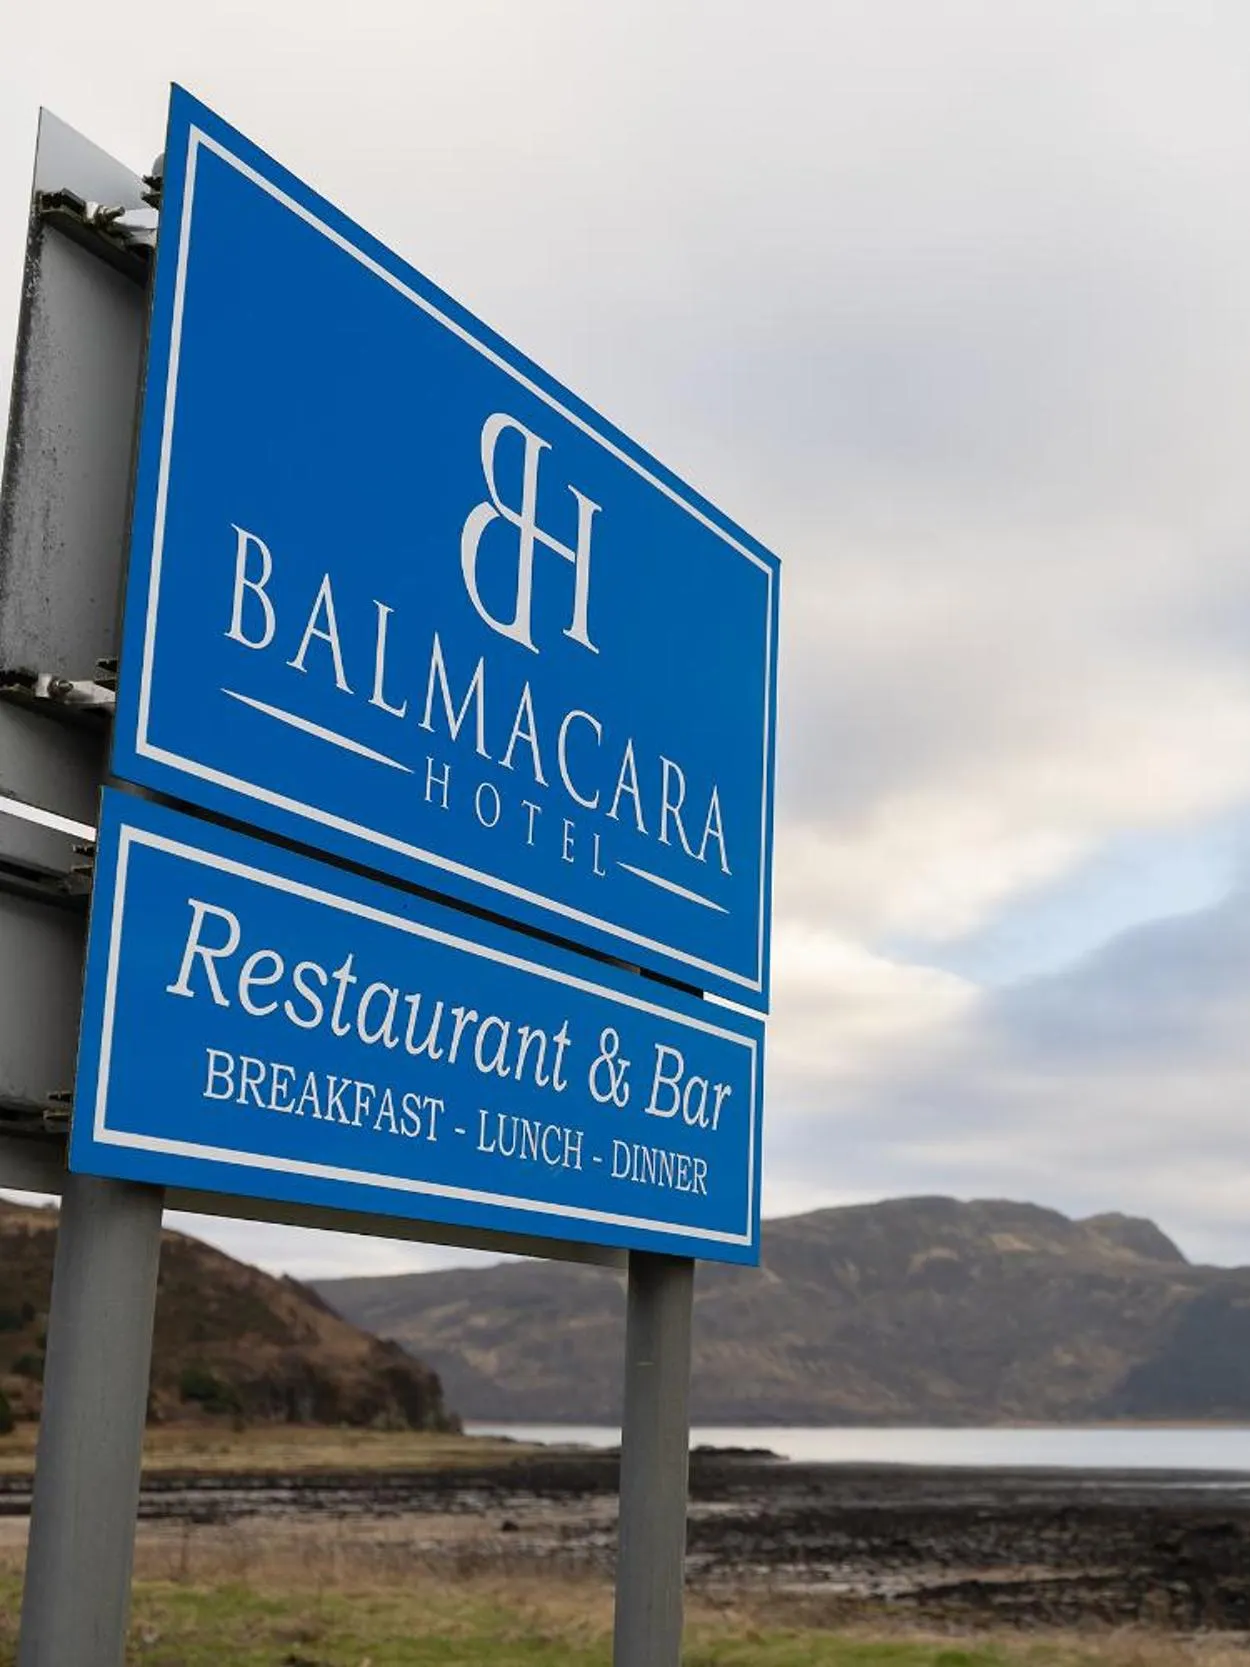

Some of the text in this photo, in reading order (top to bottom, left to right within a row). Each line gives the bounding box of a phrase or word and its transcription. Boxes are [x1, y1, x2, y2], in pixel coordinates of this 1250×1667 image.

[223, 523, 732, 875] BALMACARA
[424, 755, 608, 877] HOTEL
[166, 898, 732, 1131] Restaurant & Bar
[203, 1048, 446, 1143] BREAKFAST
[477, 1109, 584, 1171] LUNCH
[611, 1139, 709, 1196] DINNER
